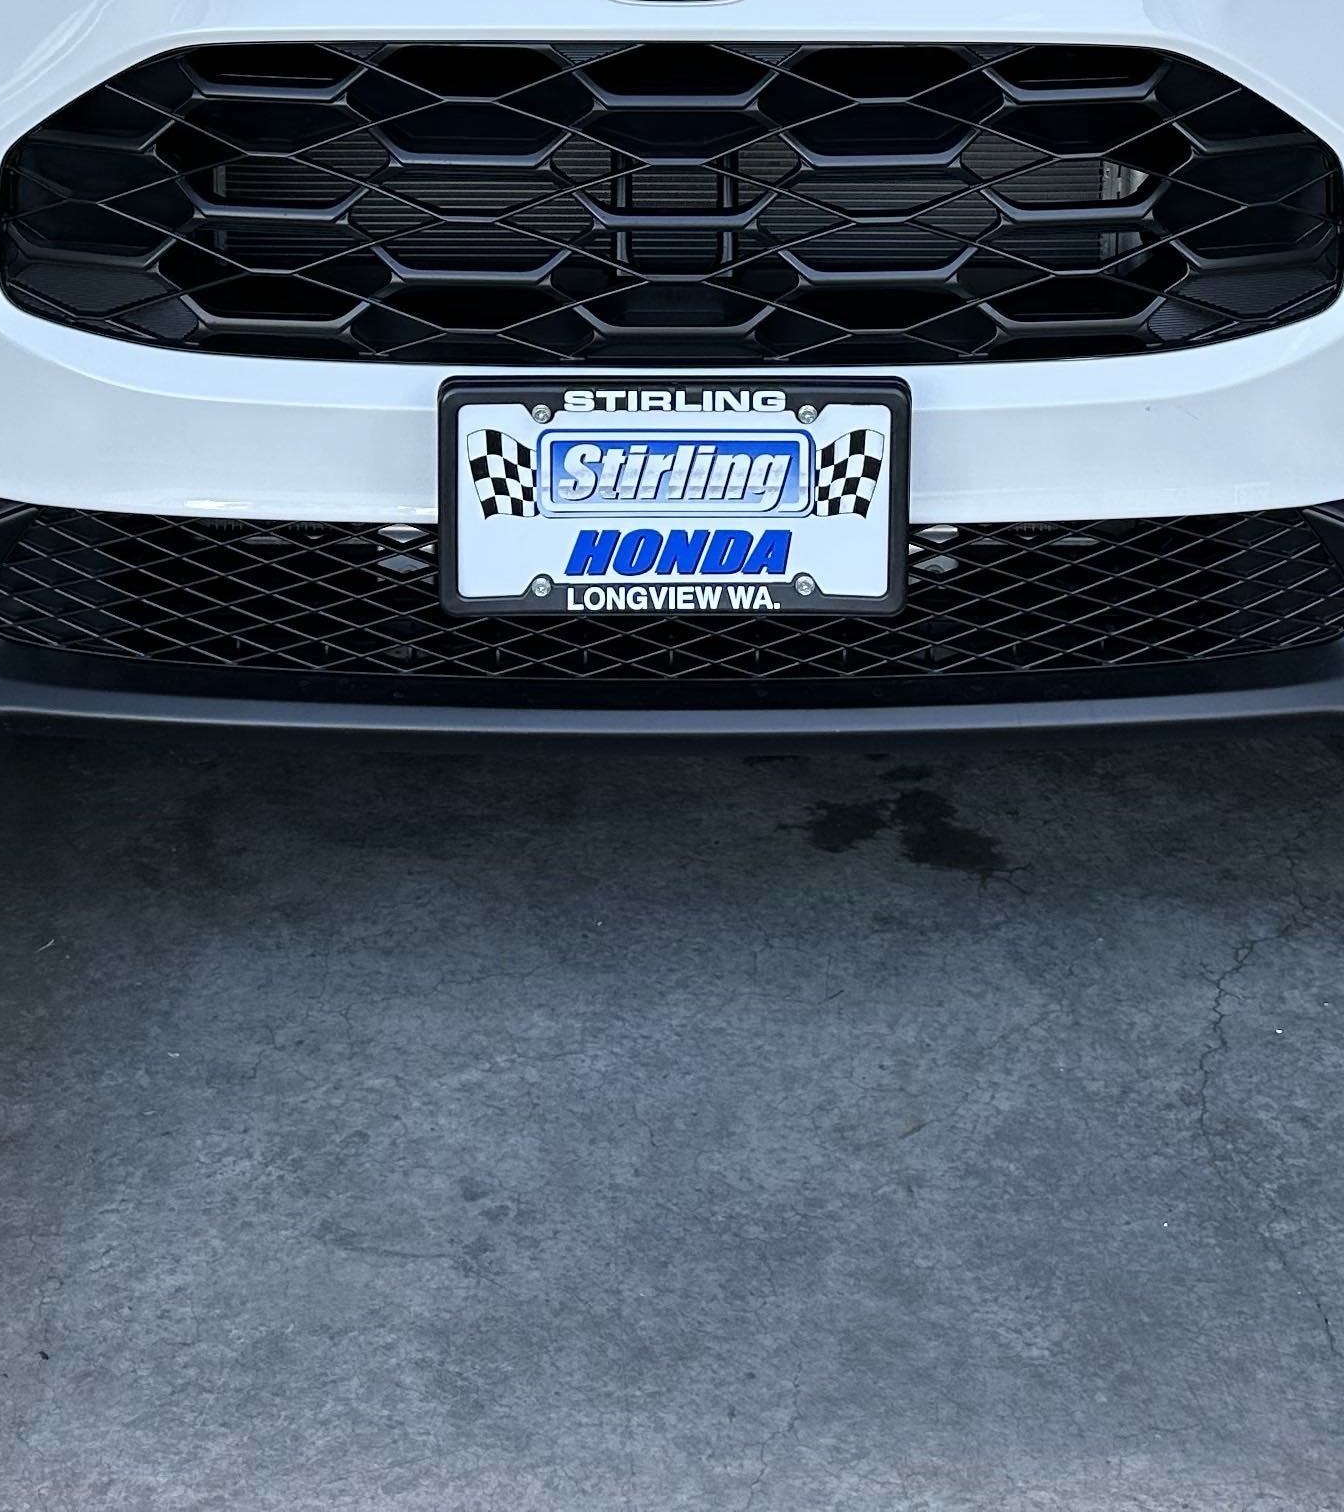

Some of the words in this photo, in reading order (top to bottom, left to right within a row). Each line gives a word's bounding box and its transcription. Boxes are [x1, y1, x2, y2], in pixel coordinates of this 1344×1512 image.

[563, 390, 787, 412] STIRLING
[558, 443, 792, 512] Stirling
[564, 529, 793, 576] HONDA
[567, 586, 723, 610] LONGVIEW
[728, 586, 781, 610] WA.
